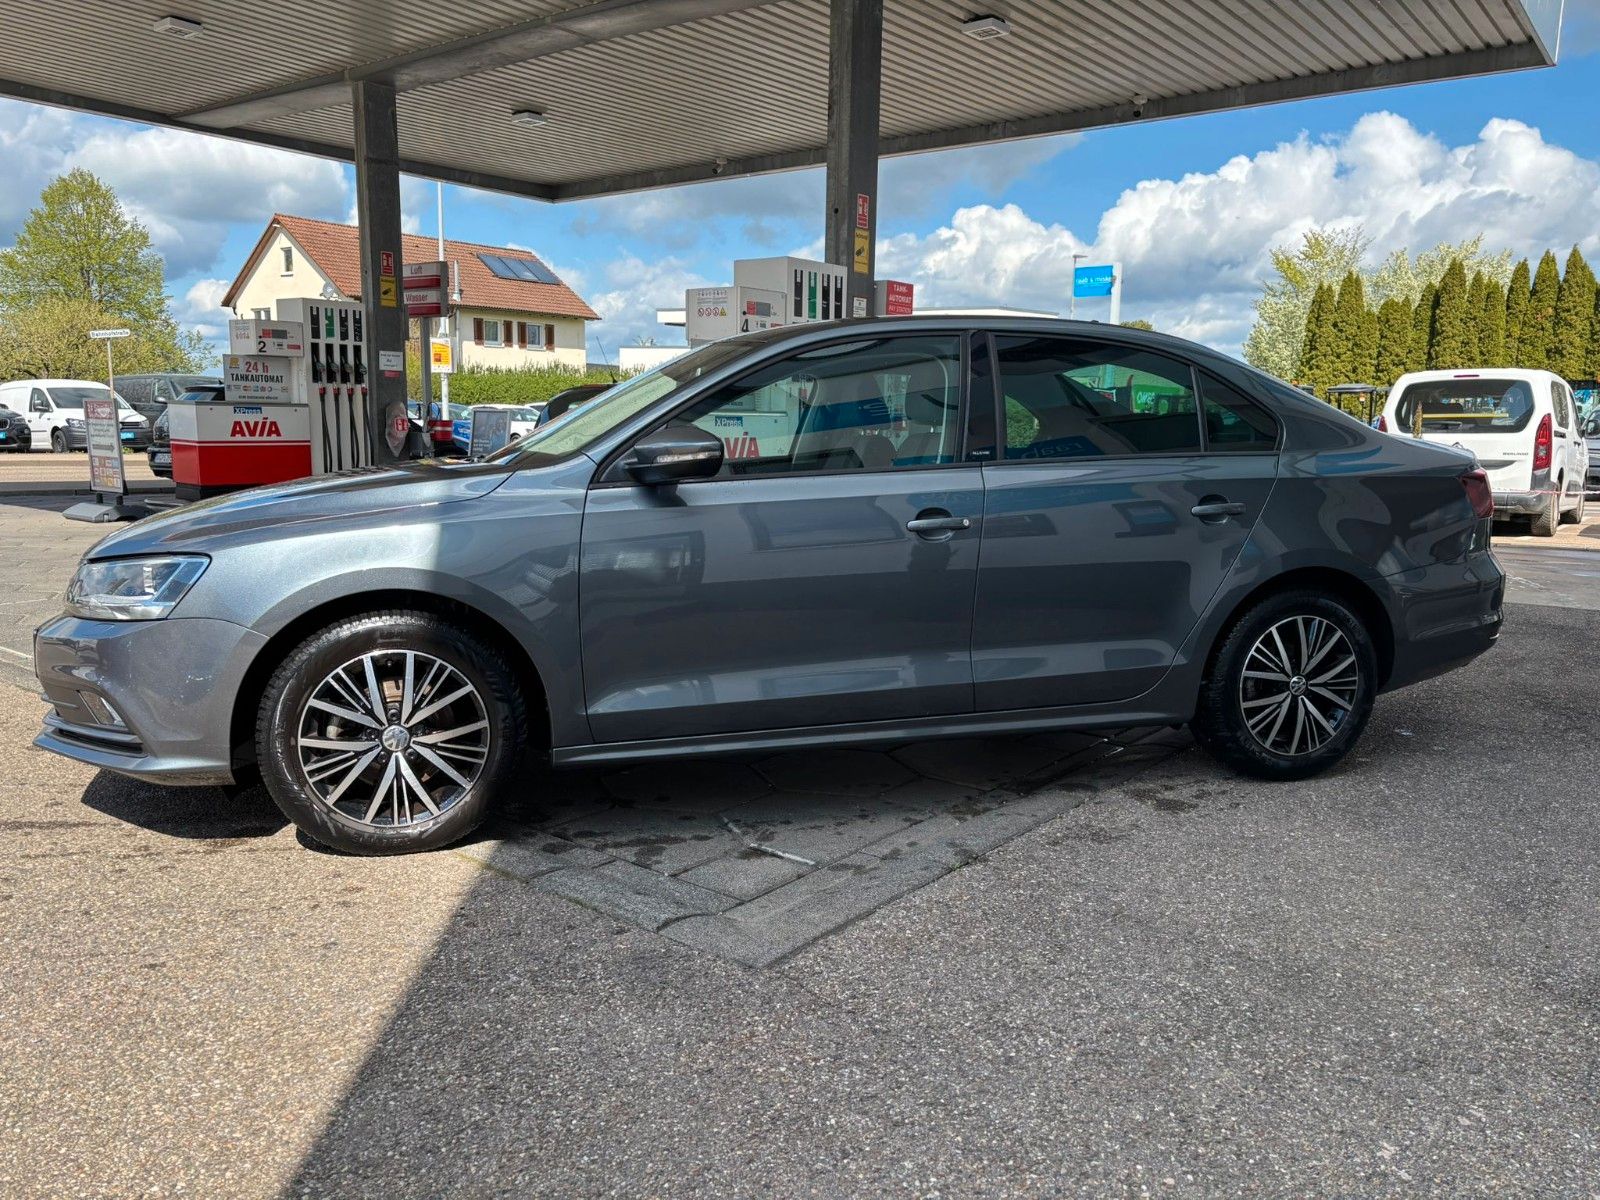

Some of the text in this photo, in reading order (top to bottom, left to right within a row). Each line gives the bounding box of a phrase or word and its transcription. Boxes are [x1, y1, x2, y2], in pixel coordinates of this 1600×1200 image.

[410, 265, 423, 275] Luft
[404, 293, 428, 302] Wasser
[888, 294, 912, 304] AUTOMAT
[741, 318, 749, 332] 4
[91, 330, 129, 338] Bahnhofstraße
[258, 340, 267, 353] 2
[244, 360, 269, 374] 24 h
[230, 373, 284, 384] TANKAUTOMAT
[233, 407, 261, 415] XPress
[715, 417, 742, 428] XPress
